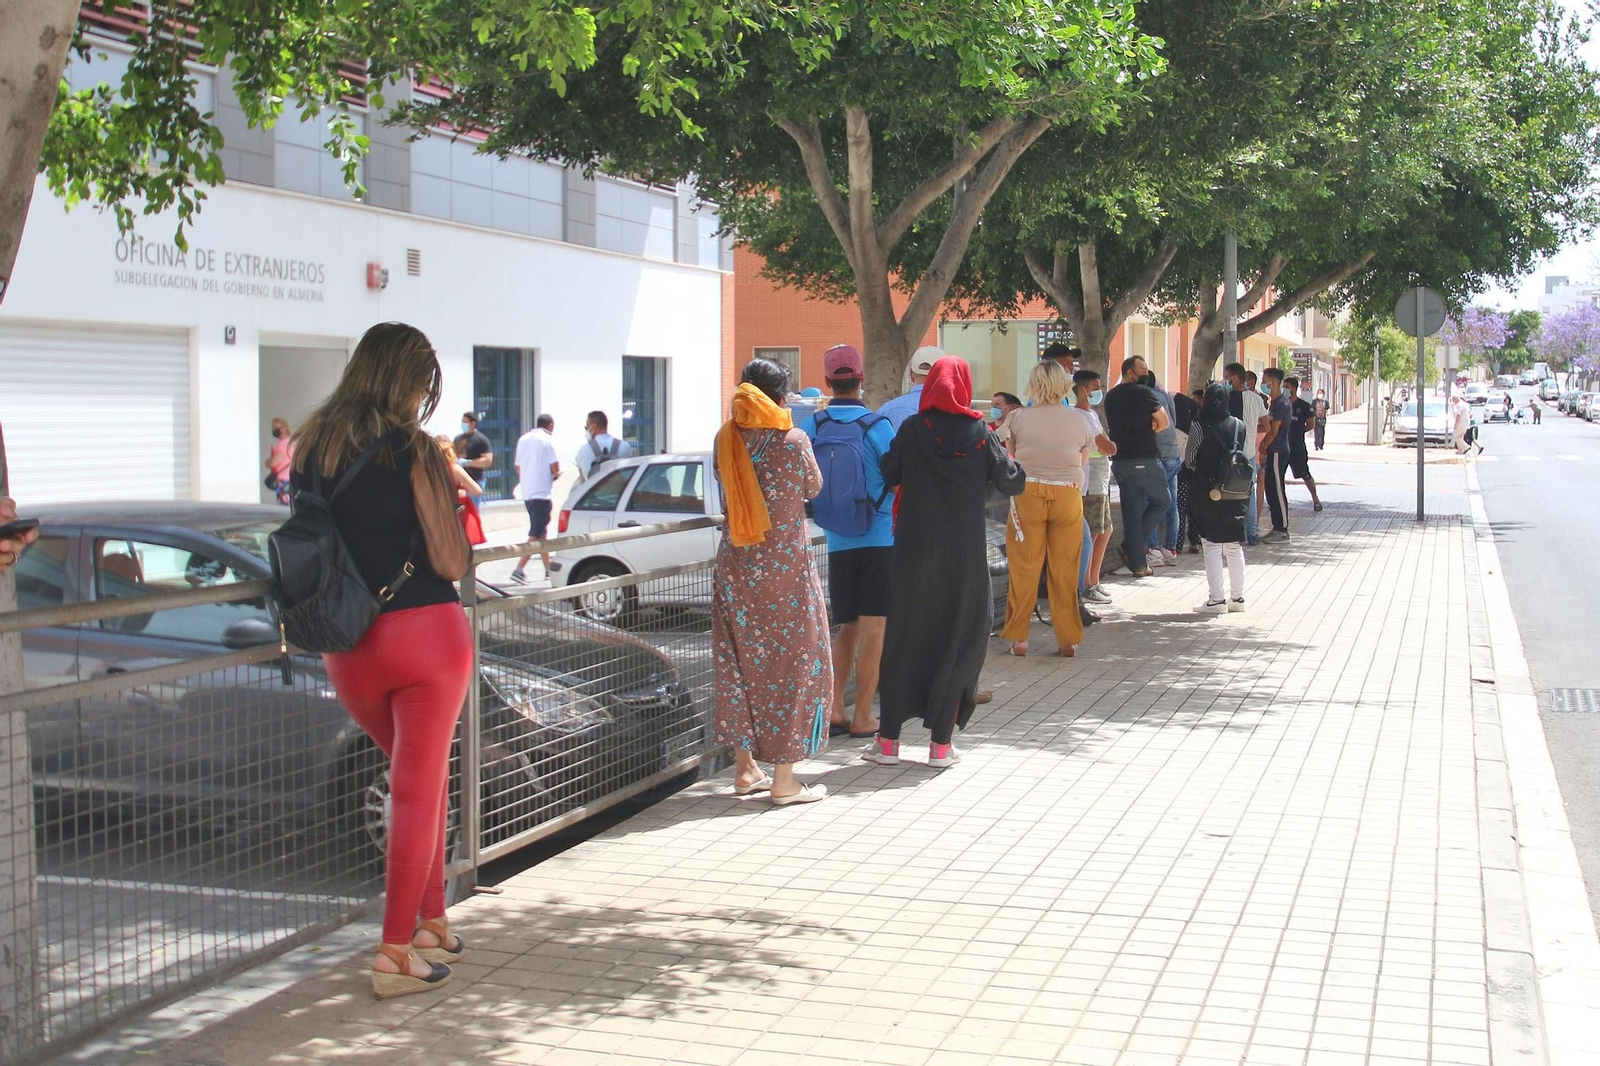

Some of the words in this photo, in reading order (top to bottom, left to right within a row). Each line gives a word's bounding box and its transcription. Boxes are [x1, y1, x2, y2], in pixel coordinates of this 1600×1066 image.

[115, 238, 187, 268] OFICINA
[195, 248, 216, 272] DE
[225, 251, 325, 284] EXTRANJEROS
[115, 269, 198, 290] SUBDELEGACION
[203, 278, 219, 293] DEL
[224, 281, 269, 298] GOBIERNO
[273, 288, 284, 299] EN
